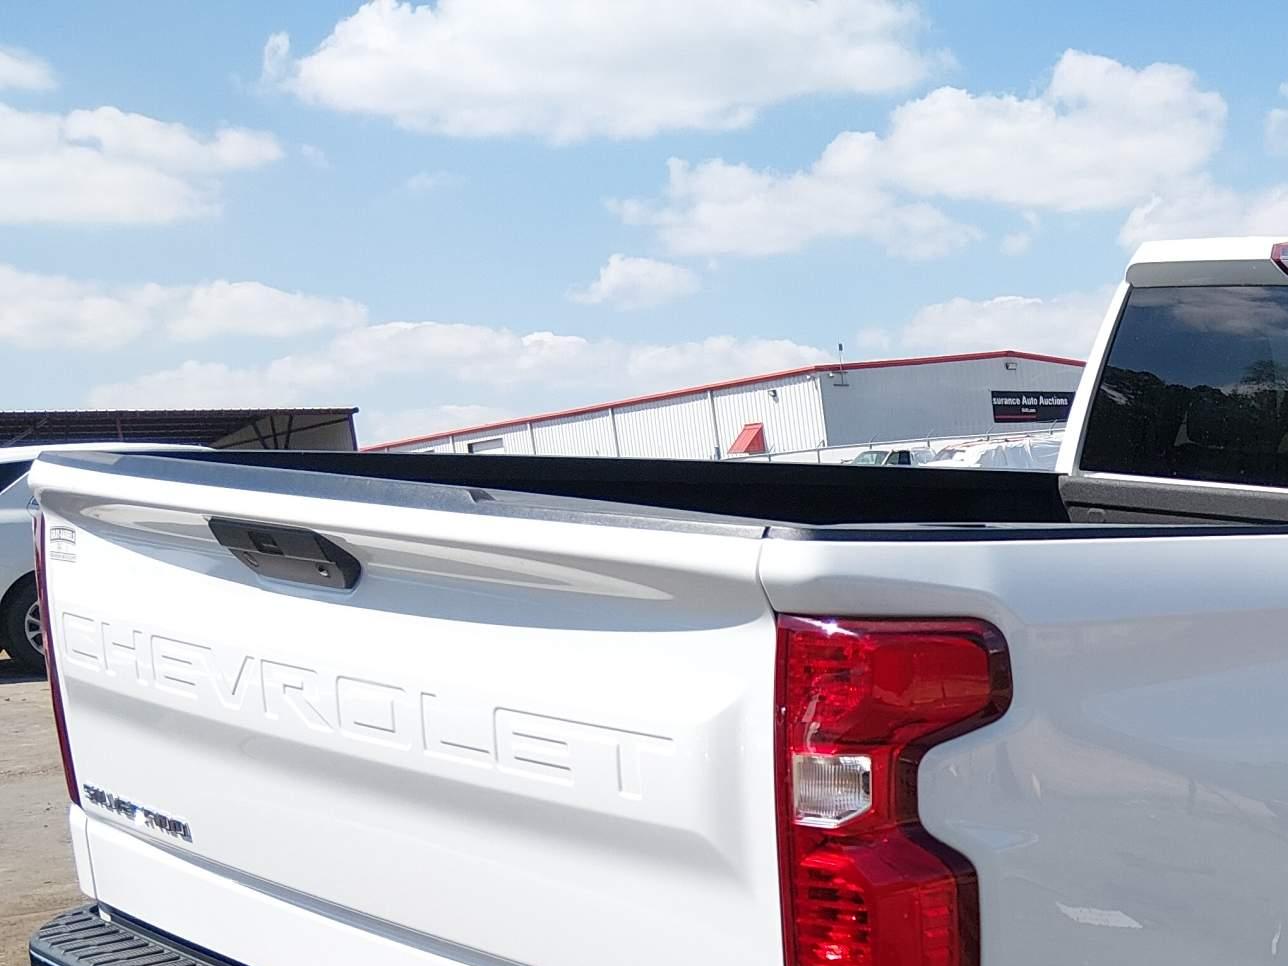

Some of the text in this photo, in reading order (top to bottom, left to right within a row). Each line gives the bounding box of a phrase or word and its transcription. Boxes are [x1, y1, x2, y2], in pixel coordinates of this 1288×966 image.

[1022, 395, 1038, 406] Auto
[1039, 395, 1068, 406] Auctions
[61, 611, 675, 801] CHEVROLET
